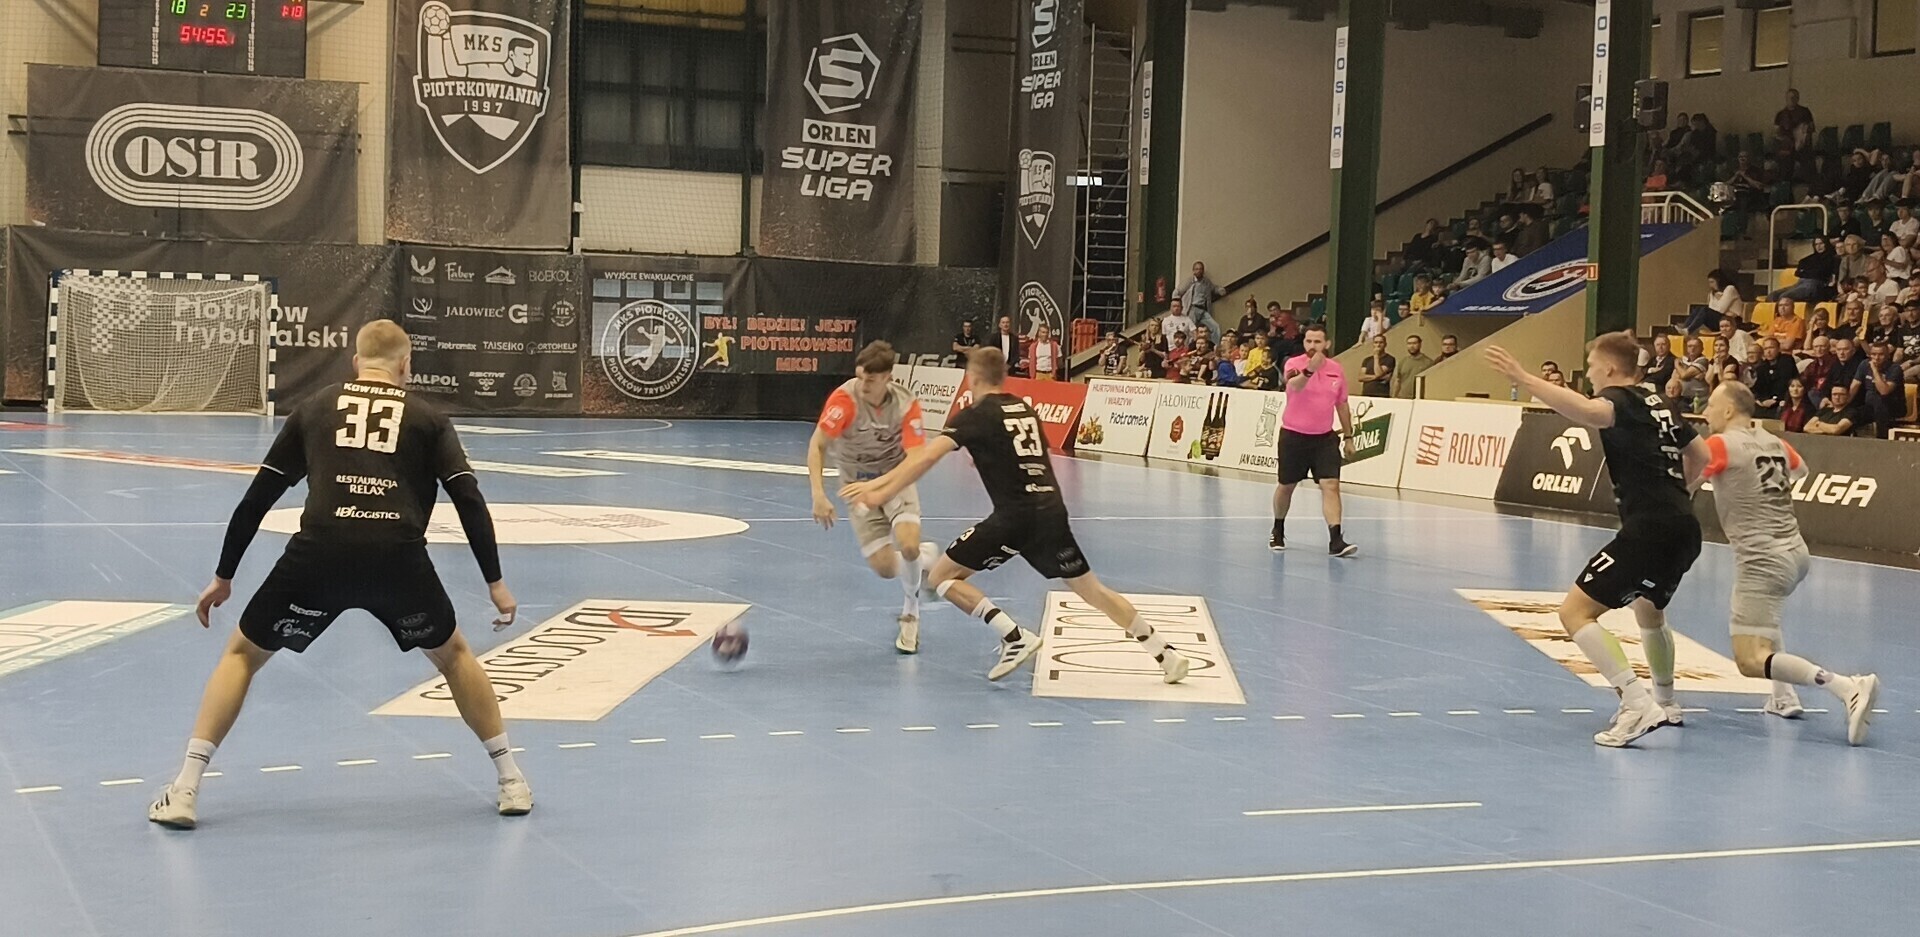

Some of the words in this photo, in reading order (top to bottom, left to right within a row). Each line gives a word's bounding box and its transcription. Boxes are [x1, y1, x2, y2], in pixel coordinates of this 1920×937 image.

[171, 0, 186, 14] 18
[200, 4, 209, 17] 2
[226, 3, 246, 18] 23
[463, 34, 503, 52] MKS
[422, 81, 543, 107] PIOTRKOWIANIN
[463, 100, 503, 114] 1997
[807, 123, 871, 145] ORLEN
[125, 136, 261, 180] OSiR
[781, 147, 893, 176] SUPER
[800, 174, 874, 201] LIGA
[444, 262, 475, 280] Faber
[604, 271, 637, 280] WYJŚCIE
[639, 272, 694, 281] EWAKUACYJNE
[613, 311, 634, 331] MKS
[635, 305, 688, 334] PIOTRCOVIA
[814, 318, 857, 333] JEST!
[171, 321, 348, 349] Trybualski
[740, 336, 853, 352] PIOTRKOWSKI
[775, 357, 818, 371] MKS!
[644, 358, 692, 394] TRYBUNALSKI
[343, 382, 406, 398] KOWALSKI
[920, 383, 955, 397] ORTOHELP
[1092, 384, 1124, 393] HURTOWNIA
[1034, 403, 1073, 425] ORLEN
[1109, 412, 1149, 427] Piotromex
[335, 395, 405, 454] 33
[1003, 416, 1043, 457] 23
[1239, 453, 1250, 465] JAN
[1448, 432, 1506, 468] ROLSTYL
[336, 474, 398, 489] RESTAURACJA
[1532, 472, 1583, 494] ORLEN
[1756, 456, 1787, 494] 27
[350, 484, 385, 496] RELAX
[1791, 473, 1877, 507] LIGA
[1591, 551, 1615, 572] 77
